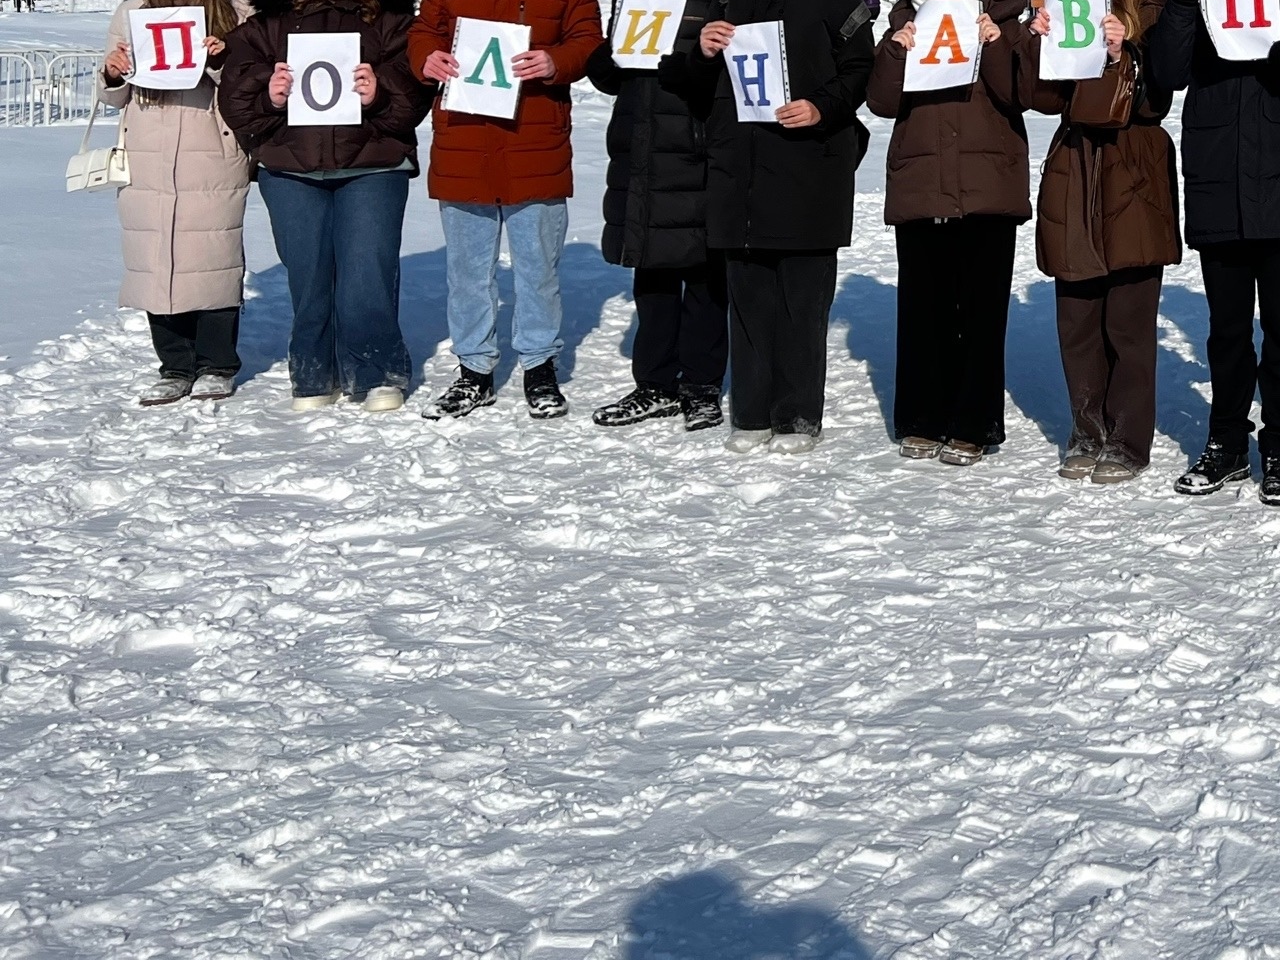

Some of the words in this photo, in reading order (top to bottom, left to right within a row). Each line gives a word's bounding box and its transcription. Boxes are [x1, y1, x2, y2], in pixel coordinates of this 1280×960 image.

[146, 21, 196, 71] П
[617, 9, 671, 55] И
[920, 14, 969, 64] А
[301, 61, 342, 112] О
[464, 37, 512, 89] Л
[732, 53, 771, 107] Н
